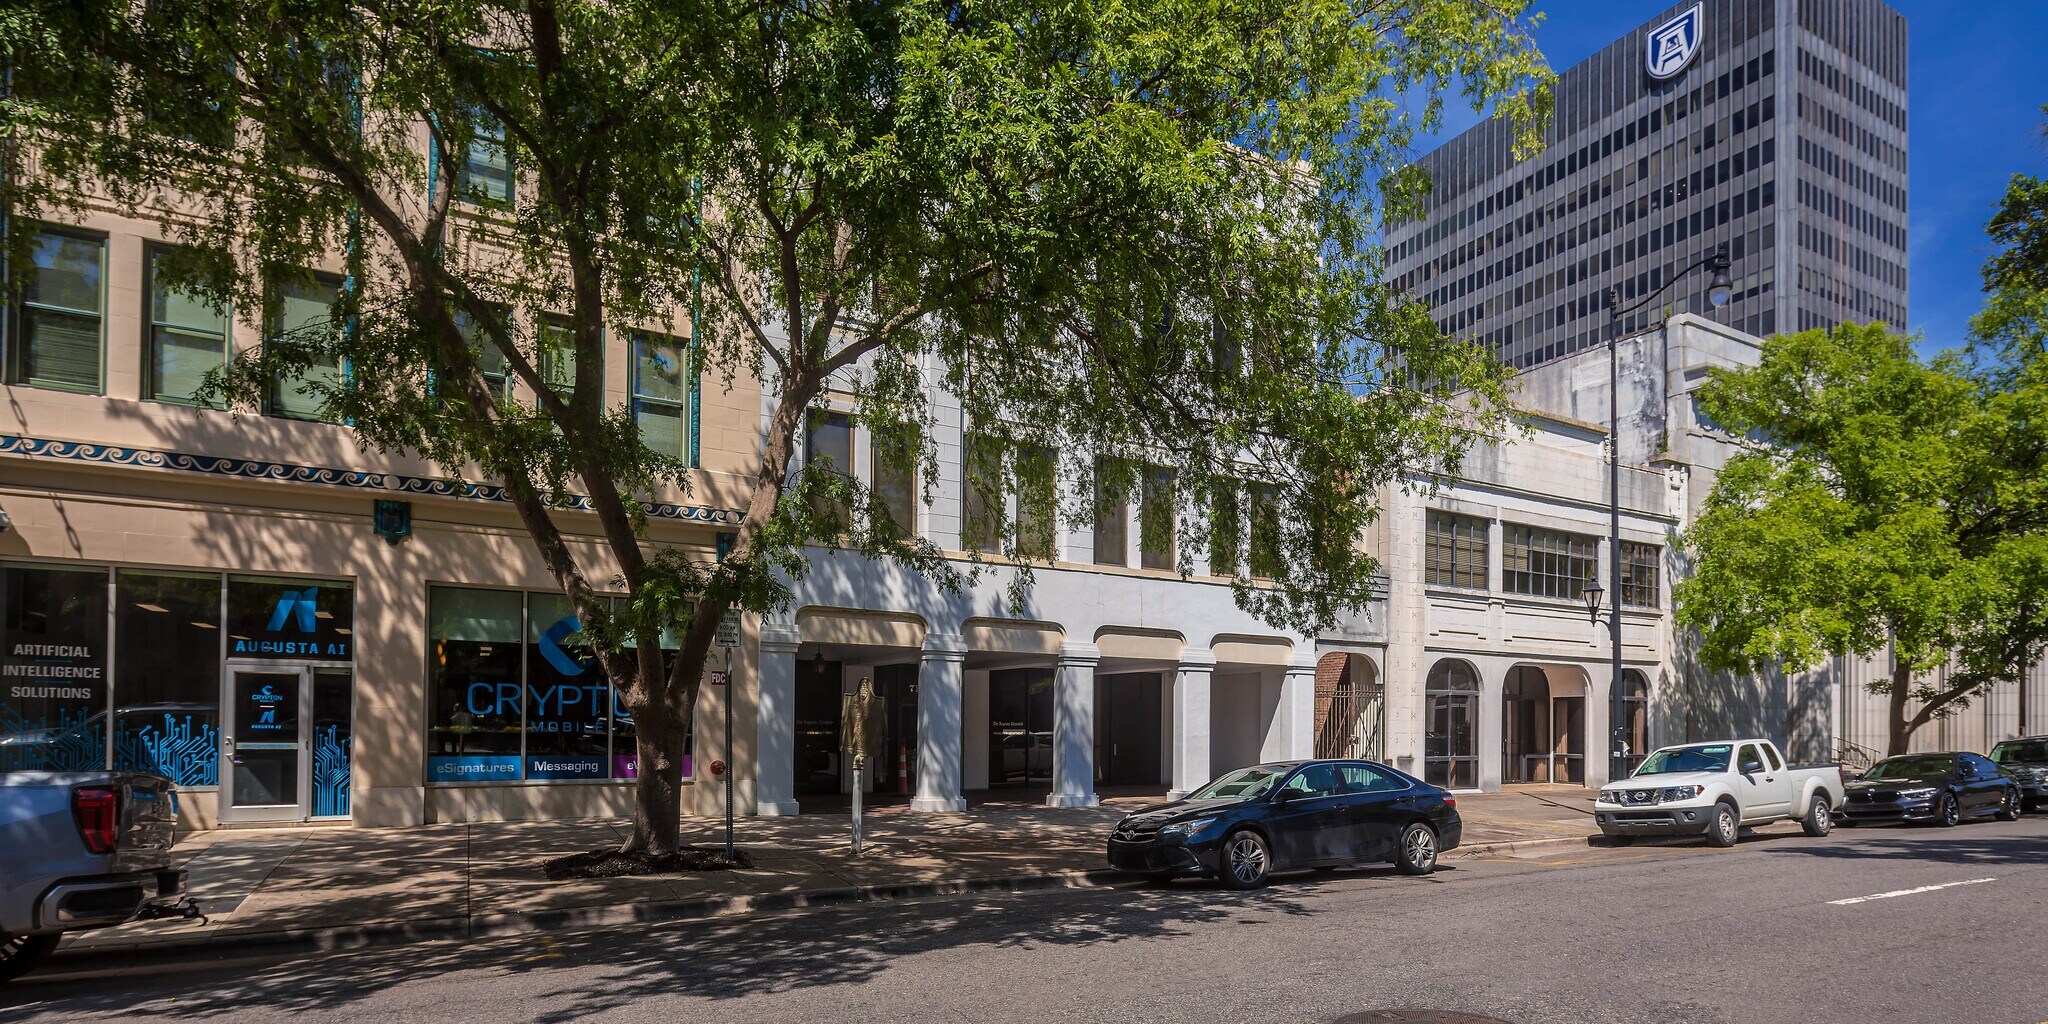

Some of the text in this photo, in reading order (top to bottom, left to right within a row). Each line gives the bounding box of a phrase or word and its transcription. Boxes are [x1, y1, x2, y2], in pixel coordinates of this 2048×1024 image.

[13, 643, 92, 658] ARTIFICIAL
[235, 640, 346, 656] AUGUSTA AI
[2, 664, 101, 679] INTELLIGENCE
[711, 673, 726, 683] FDC
[11, 686, 92, 699] SOLUTIONS
[531, 721, 604, 733] MOBILE
[436, 762, 515, 776] eSignatures
[534, 761, 599, 773] Messaging
